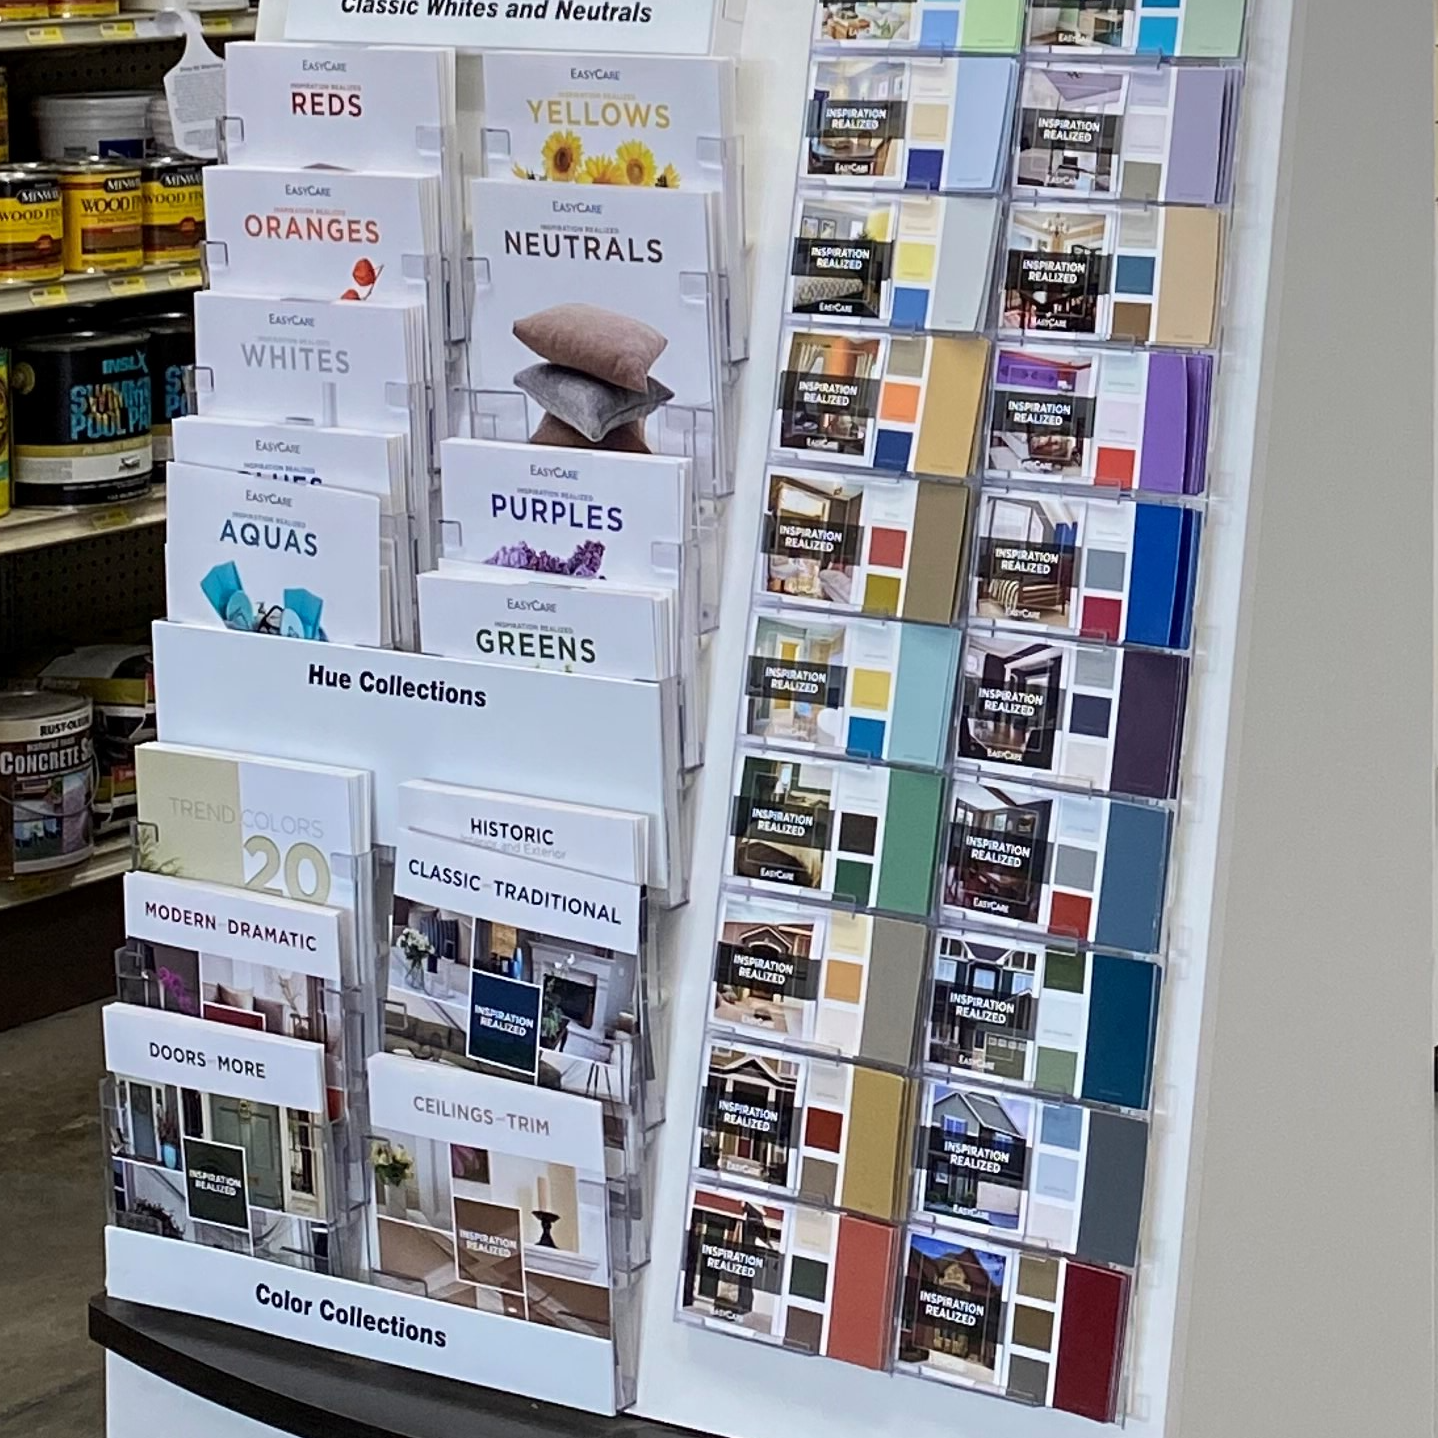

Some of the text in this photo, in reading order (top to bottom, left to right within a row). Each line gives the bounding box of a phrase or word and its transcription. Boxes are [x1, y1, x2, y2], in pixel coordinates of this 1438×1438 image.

[506, 1, 547, 19] and
[555, 0, 652, 23] Neutrals
[292, 92, 362, 117] REDS
[527, 100, 671, 128] YELLOWS
[826, 108, 886, 119] INSPIRATION
[832, 119, 879, 130] REALIZED
[1039, 118, 1100, 132] INSPIRATION
[1044, 129, 1092, 142] REALIZED
[244, 214, 380, 244] ORANGES
[504, 230, 664, 263] NEUTRALS
[811, 247, 870, 260] INSPIRATION
[817, 257, 862, 270] REALIZED
[1023, 260, 1085, 273] INSPIRATION
[1028, 271, 1078, 283] REALIZED
[242, 343, 350, 374] WHITES
[799, 381, 857, 396] INSPIRATION
[804, 392, 849, 406] REALIZED
[1008, 400, 1070, 415] INSPIRATION
[1014, 411, 1063, 425] REALIZED
[491, 493, 623, 532] PURPLES
[220, 519, 318, 557] AQUAS
[779, 525, 842, 541] INSPIRATION
[785, 536, 834, 552] REALIZED
[995, 547, 1058, 563] INSPIRATION
[1001, 559, 1050, 574] REALIZED
[476, 629, 596, 663] GREENS
[765, 666, 826, 682] INSPIRATION
[308, 664, 487, 707] Hue Collections
[771, 678, 818, 693] REALIZED
[978, 688, 1042, 704] INSPIRATION
[985, 699, 1034, 715] REALIZED
[0, 746, 79, 774] CONCRETE
[169, 796, 325, 840] TREND COLORS
[752, 808, 813, 826] INSPIRATION
[470, 817, 554, 846] HISTORIC
[758, 820, 806, 836] REALIZED
[966, 836, 1030, 856] INSPIRATION
[972, 848, 1021, 867] REALIZED
[244, 834, 331, 905] 20
[408, 858, 621, 926] CLASSIC TRADITIONAL
[145, 901, 318, 953] MODERN DRAMATIC
[734, 954, 793, 973] INSPIRATION
[739, 967, 785, 984] REALIZED
[950, 993, 1014, 1013] INSPIRATION
[474, 1005, 534, 1028] INSPIRATION
[956, 1005, 1006, 1024] REALIZED
[481, 1017, 527, 1036] REALIZED
[149, 1041, 267, 1080] DOORS MORE
[413, 1095, 550, 1137] CEILINGS TRIM
[718, 1101, 778, 1122] INSPIRATION
[724, 1113, 770, 1131] REALIZED
[945, 1141, 1009, 1162] INSPIRATION
[950, 1153, 1001, 1173] REALIZED
[190, 1169, 241, 1189] INSPIRATION
[195, 1180, 237, 1198] REALIZED
[459, 1228, 517, 1250] INSPIRATION
[466, 1241, 511, 1259] REALIZED
[702, 1244, 763, 1267] INSPIRATION
[708, 1257, 755, 1277] REALIZED
[920, 1292, 984, 1315] INSPIRATION
[255, 1282, 447, 1349] Color Collections
[926, 1305, 976, 1325] REALIZED
